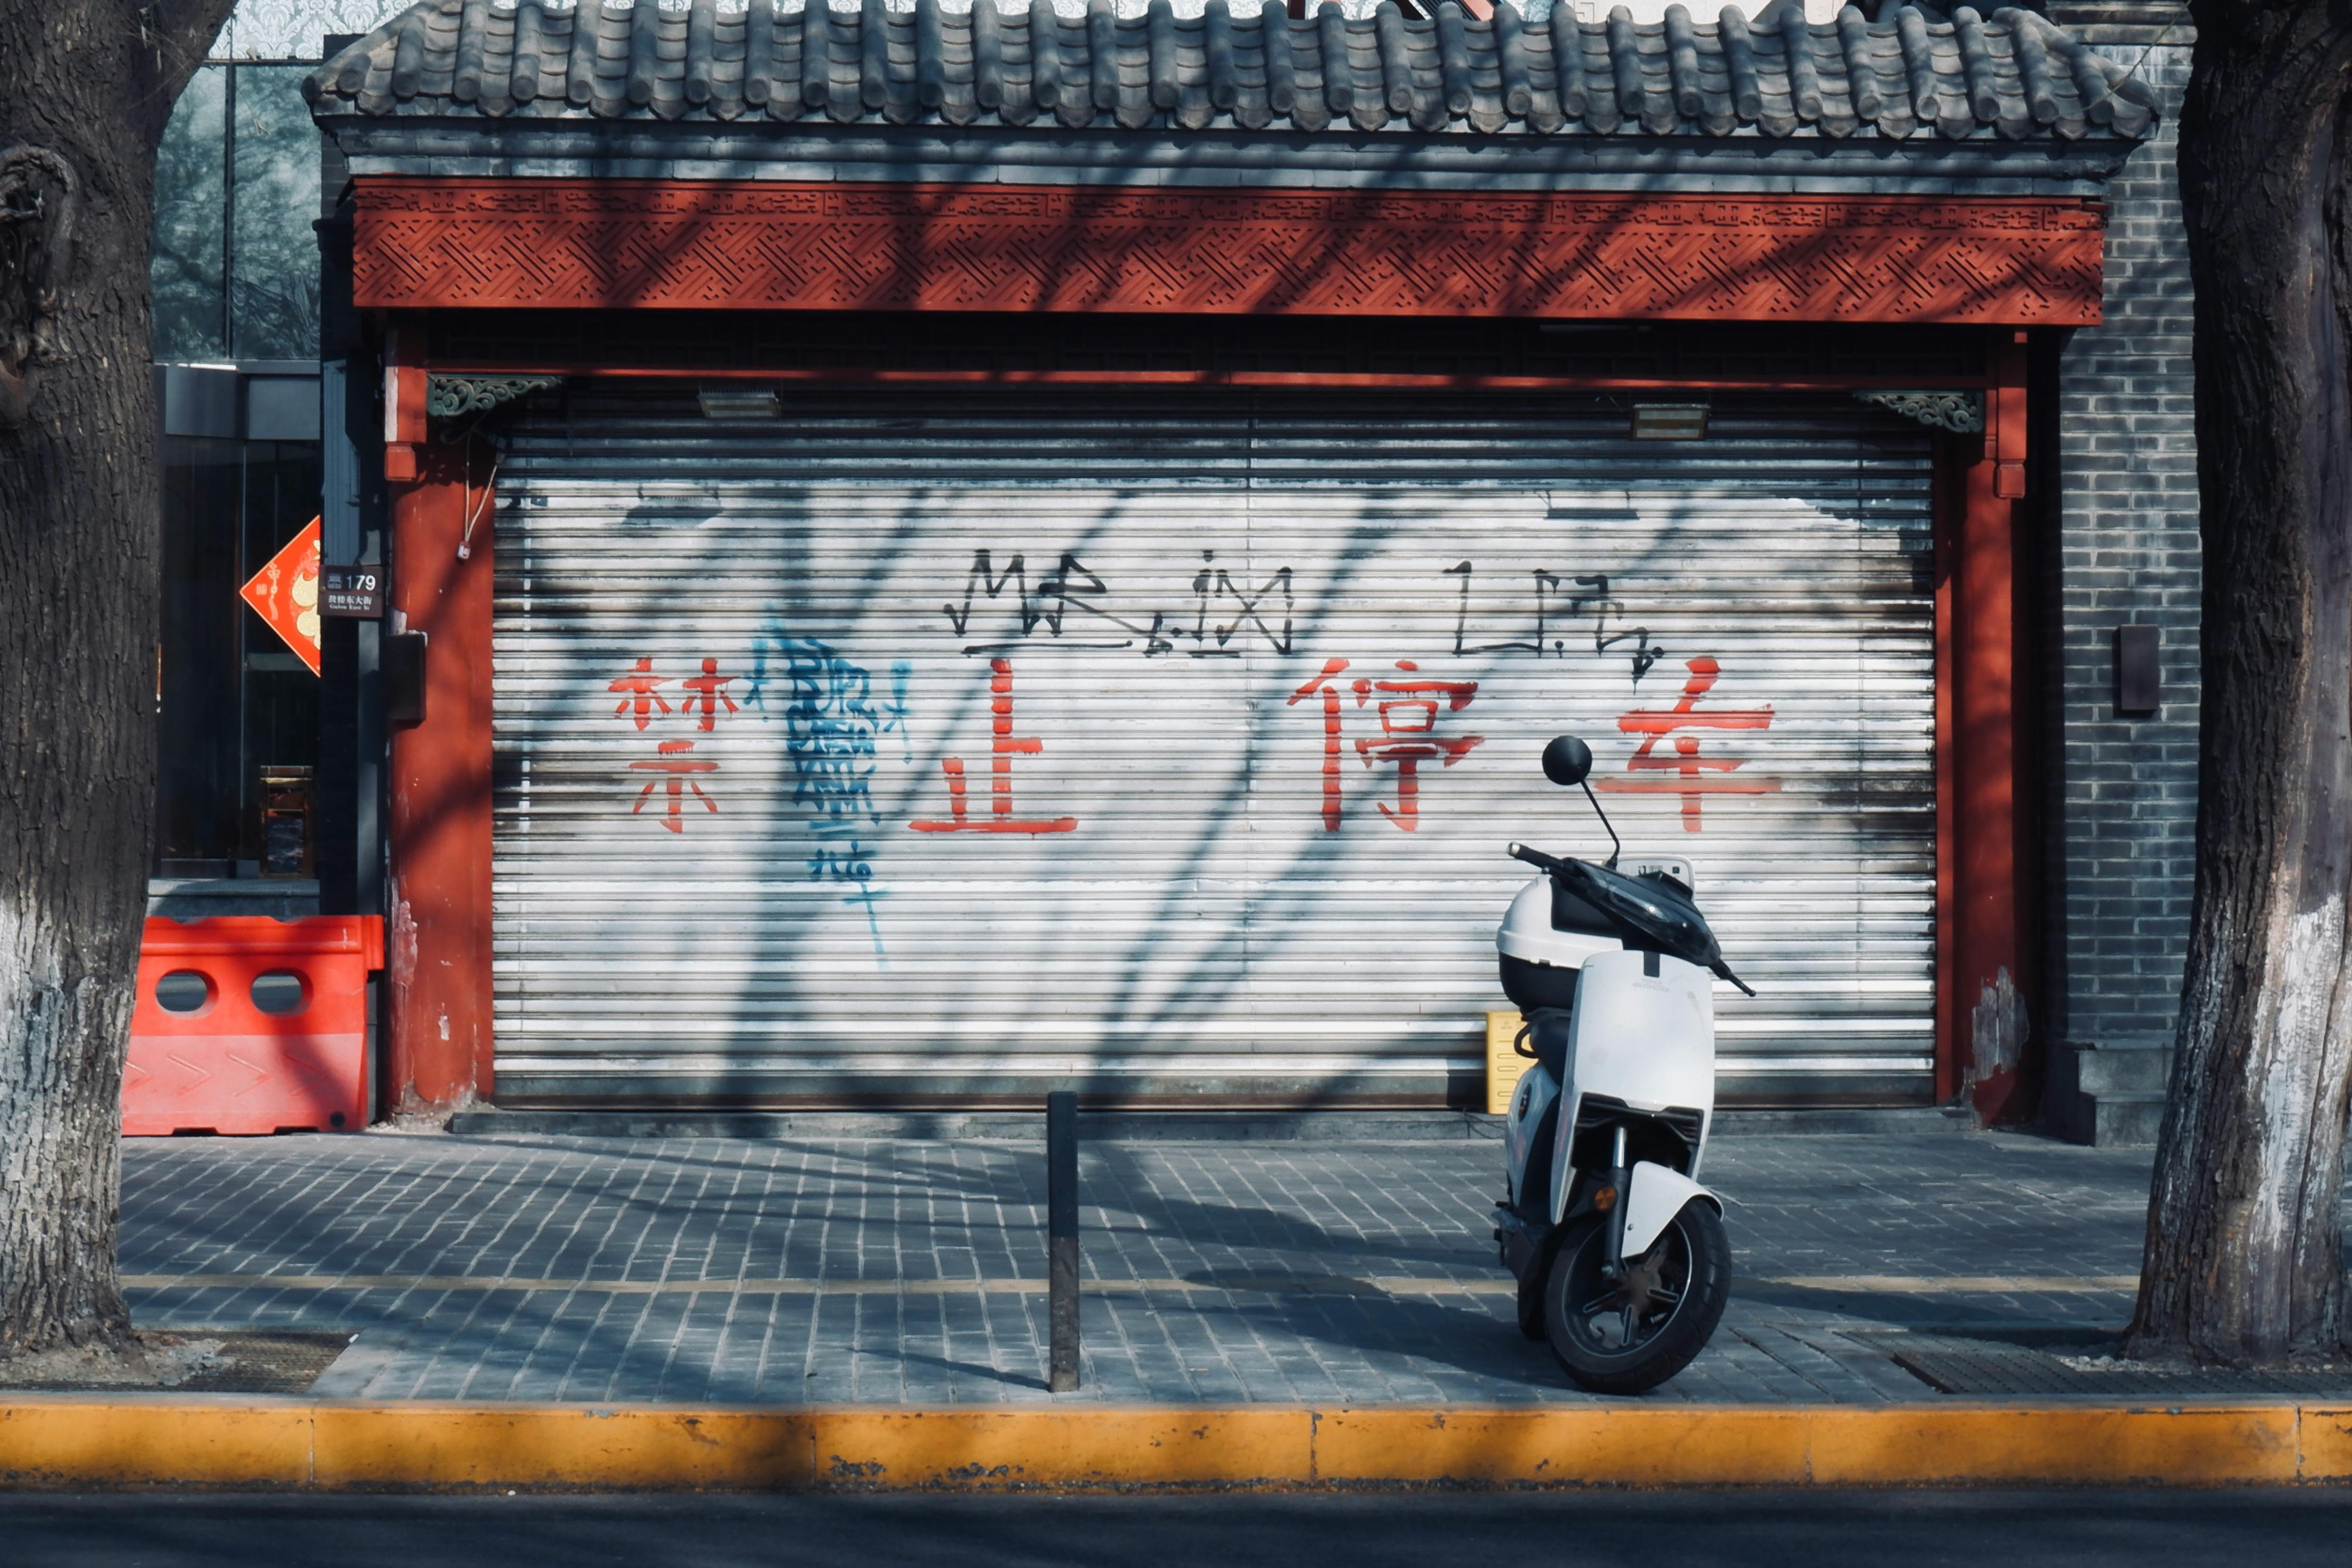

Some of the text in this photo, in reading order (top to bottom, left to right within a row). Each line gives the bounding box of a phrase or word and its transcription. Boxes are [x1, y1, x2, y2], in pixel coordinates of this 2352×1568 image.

[346, 575, 376, 591] 179
[328, 595, 372, 605] 鼓楼东大街
[608, 657, 1781, 833] 禁止停车
